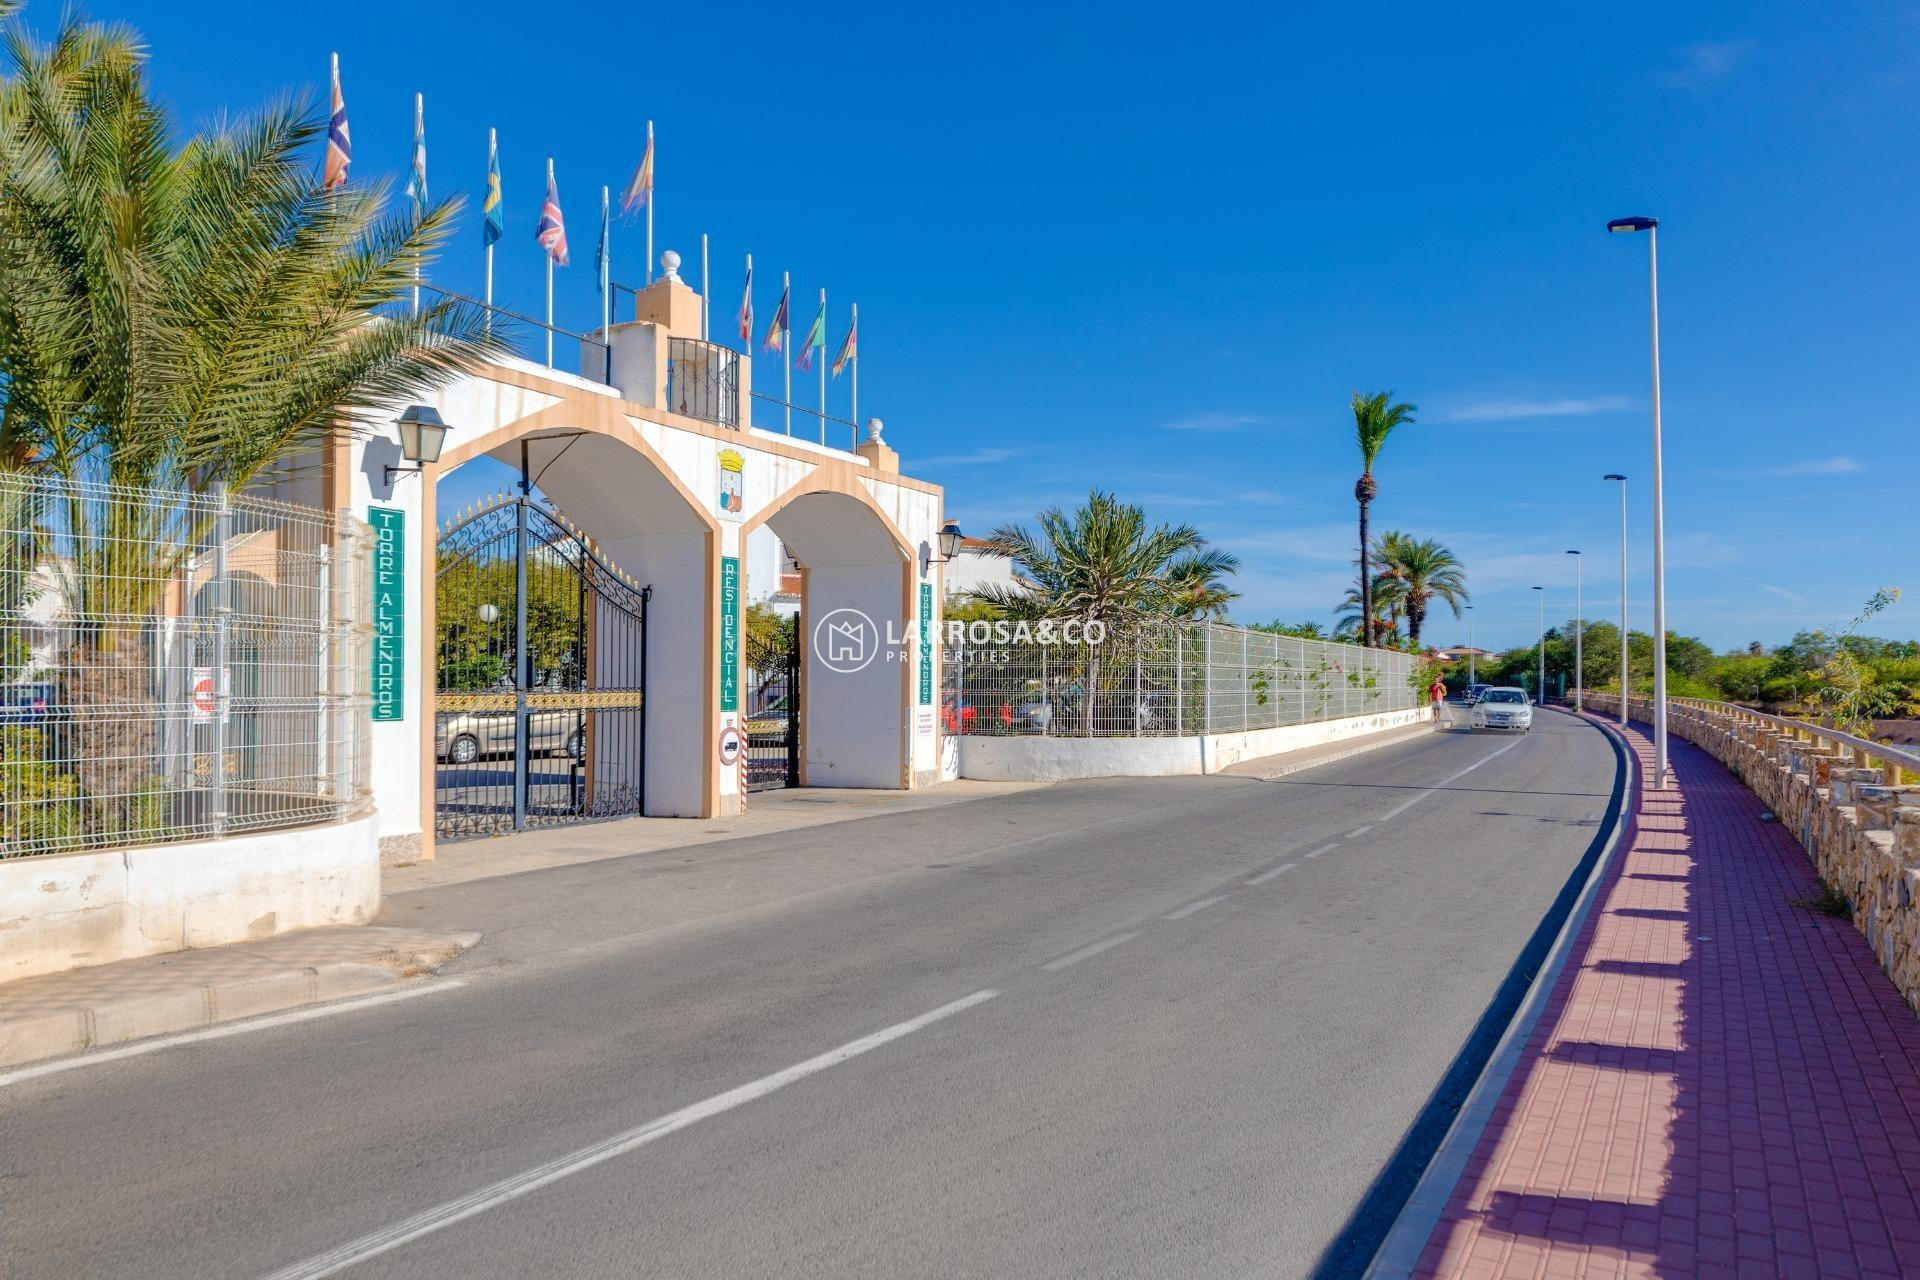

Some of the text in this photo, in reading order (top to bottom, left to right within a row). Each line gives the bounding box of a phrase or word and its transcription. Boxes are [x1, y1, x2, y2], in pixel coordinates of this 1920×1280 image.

[379, 513, 393, 718] TORRE ALMENDROS
[724, 563, 736, 703] RESIDENCIAL
